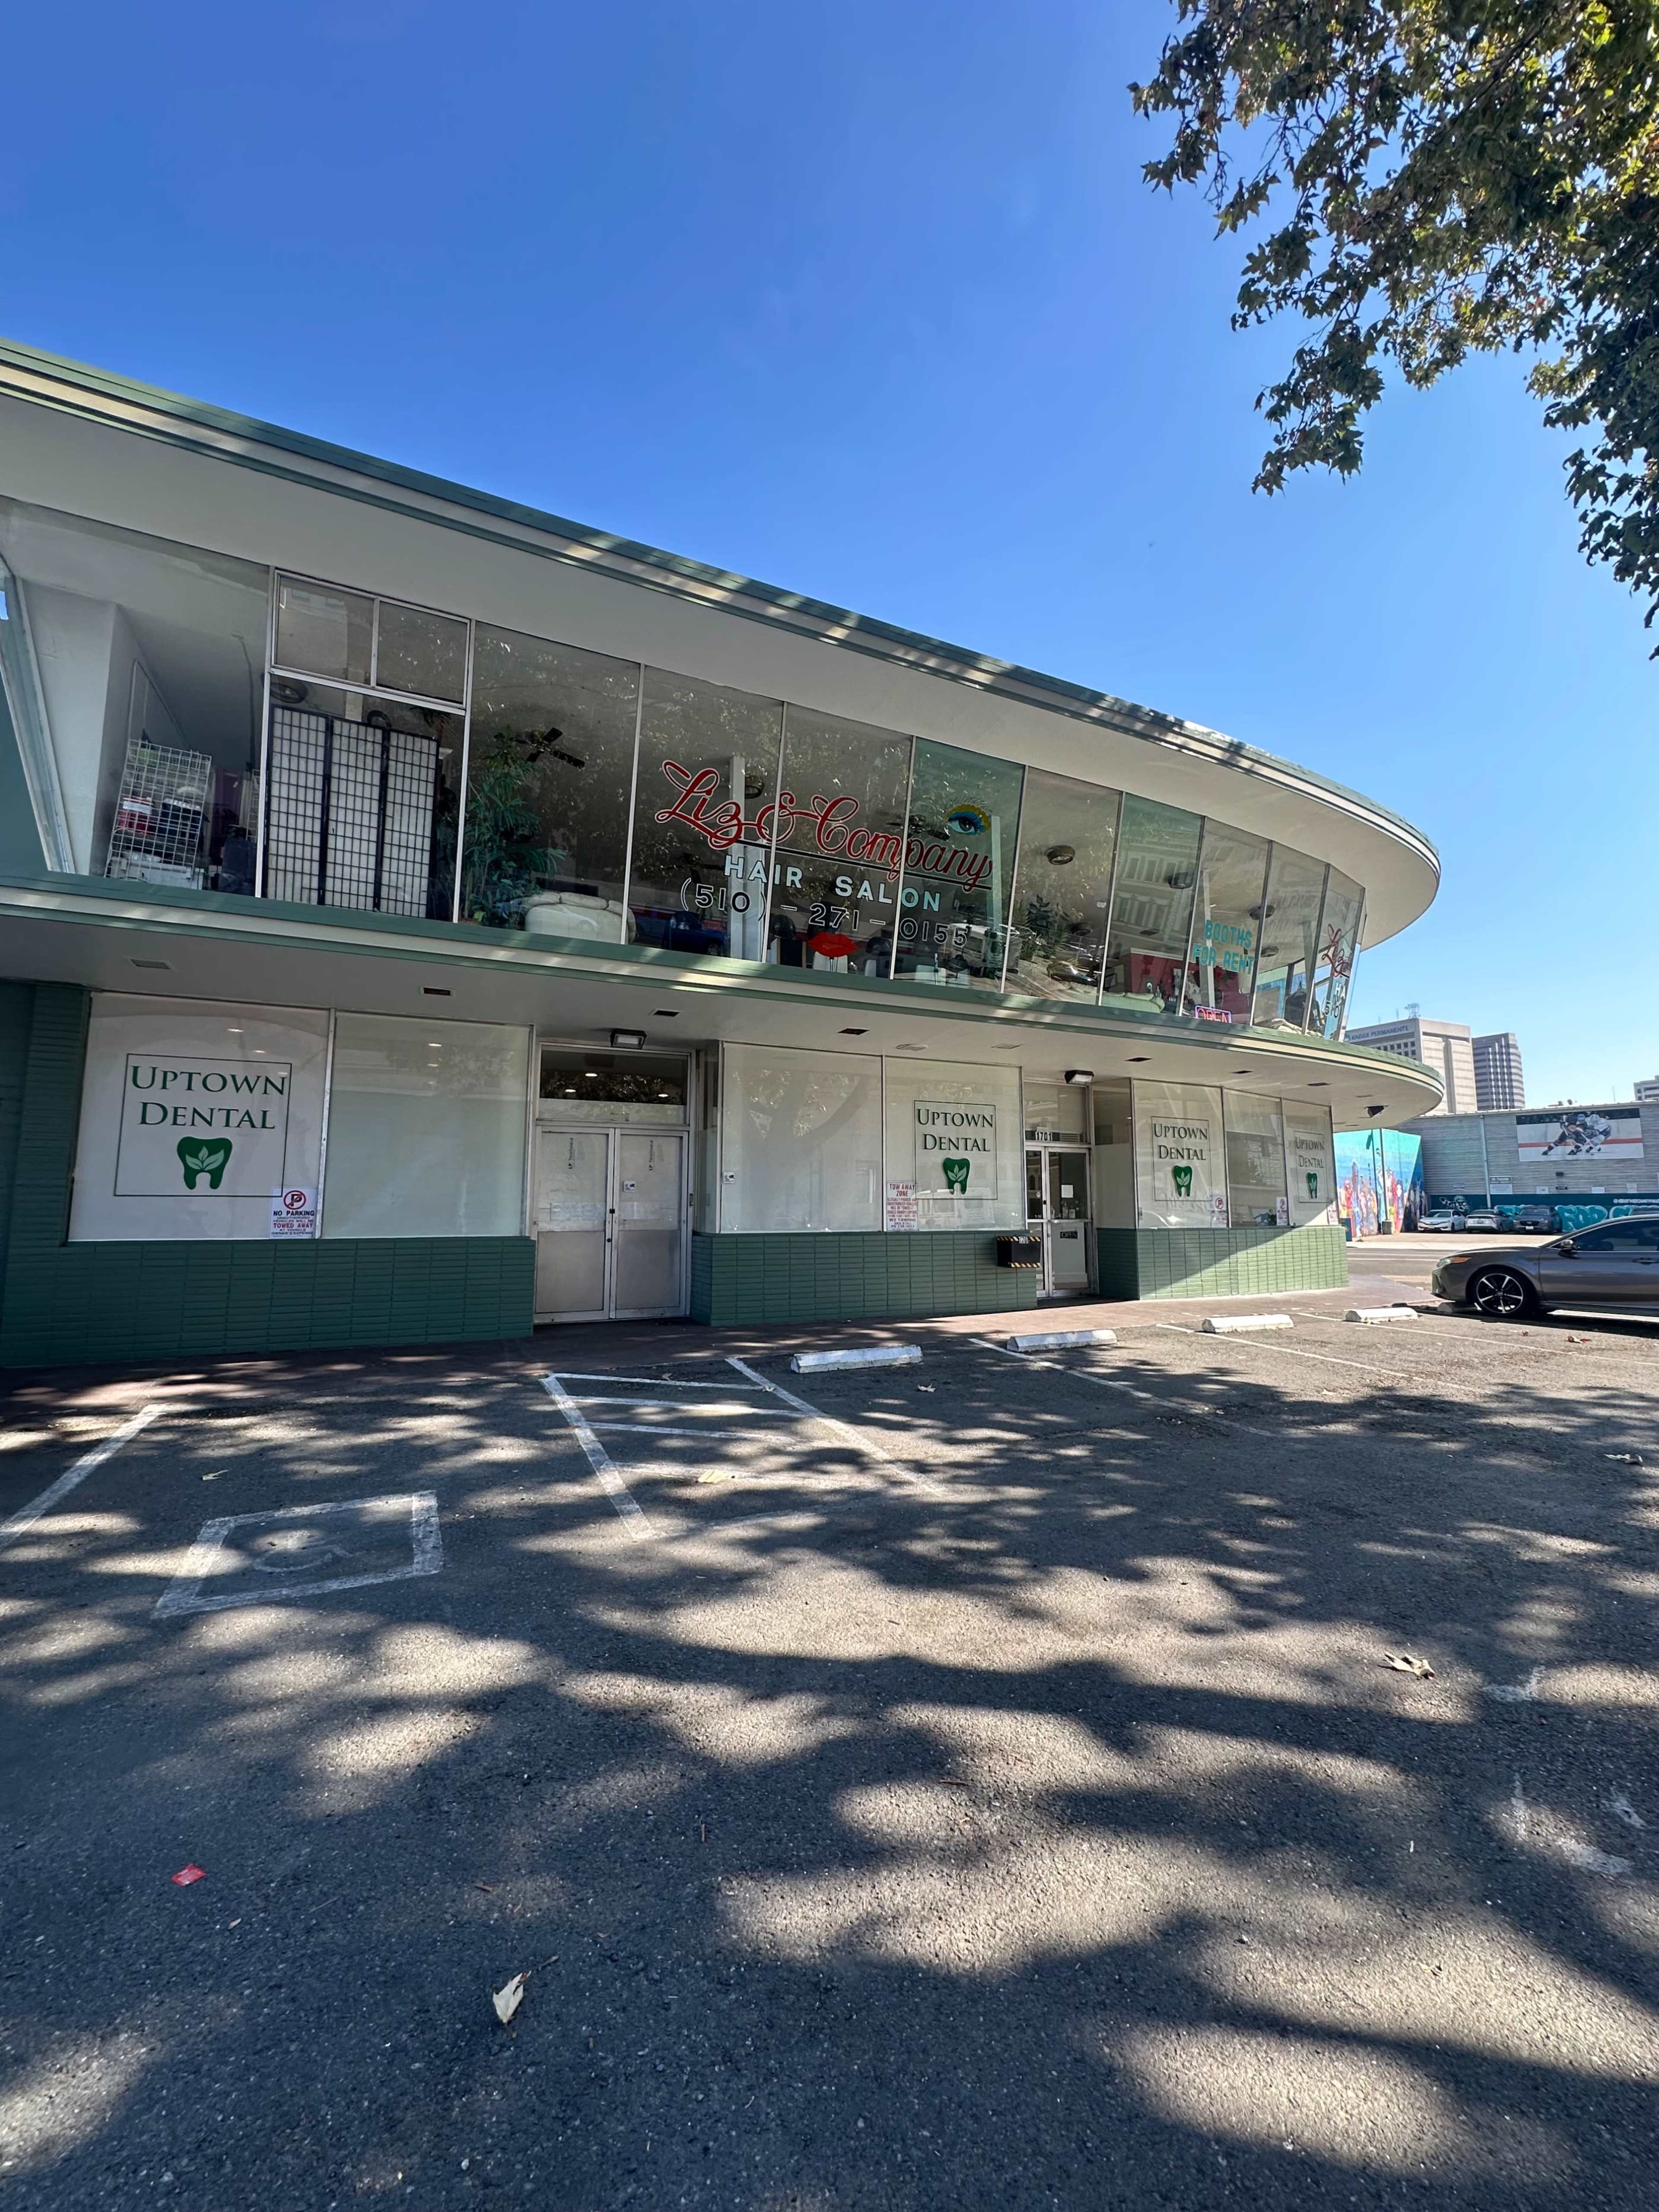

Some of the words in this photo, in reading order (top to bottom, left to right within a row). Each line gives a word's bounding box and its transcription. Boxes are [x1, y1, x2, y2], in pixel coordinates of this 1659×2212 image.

[655, 760, 743, 850] Liz
[811, 795, 993, 893] Company
[724, 854, 804, 889] HAIR
[835, 875, 941, 912] SALON
[680, 877, 767, 922] (510)
[899, 917, 971, 947] 0155
[1204, 919, 1252, 950] BOOTHS
[1192, 942, 1217, 967] FOR
[1223, 950, 1255, 975] RENT
[1322, 923, 1345, 978] Liz
[1197, 1008, 1230, 1023] OPEN
[1351, 1032, 1370, 1040] KAISER
[1370, 1025, 1409, 1036] PERMANENTE
[132, 1065, 287, 1096] UPTOWN
[139, 1101, 275, 1130] DENTAL
[917, 1109, 994, 1128] UPTOWN
[1036, 1131, 1052, 1141] 1701
[1154, 1123, 1208, 1140] UPTOWN
[923, 1134, 991, 1152] DENTAL
[1296, 1137, 1325, 1151] UPTOWN
[1158, 1145, 1206, 1161] DENTAL
[1299, 1155, 1325, 1168] DENTAL
